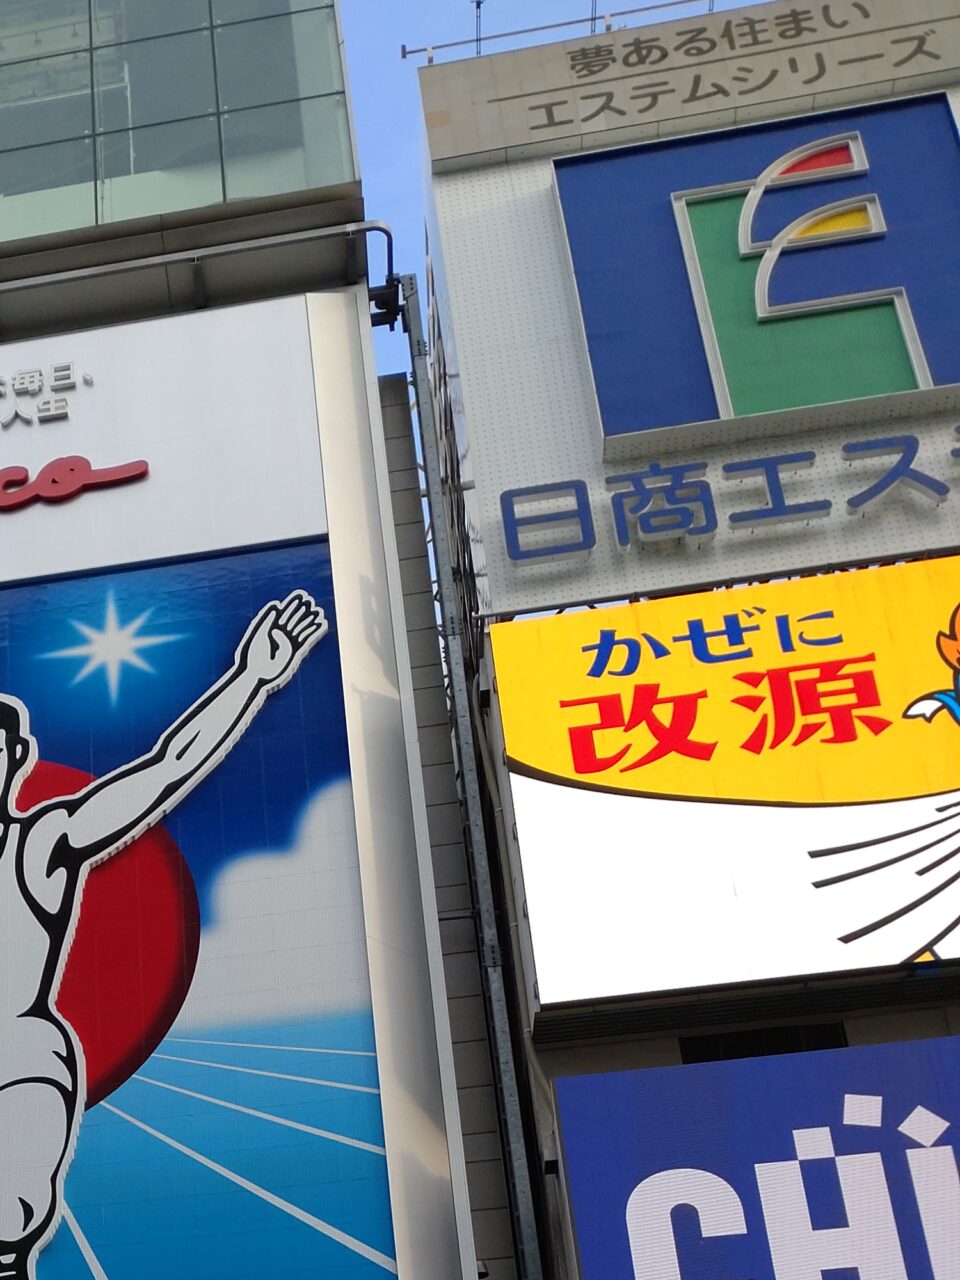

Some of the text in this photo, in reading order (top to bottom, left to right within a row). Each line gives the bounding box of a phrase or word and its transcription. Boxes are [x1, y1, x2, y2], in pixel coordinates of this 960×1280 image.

[529, 29, 942, 131] エステムシリーズ
[566, 1, 872, 79] 夢ある住まい
[500, 425, 960, 563] 日商エス
[581, 606, 844, 679] かぜに
[558, 652, 894, 775] 改源
